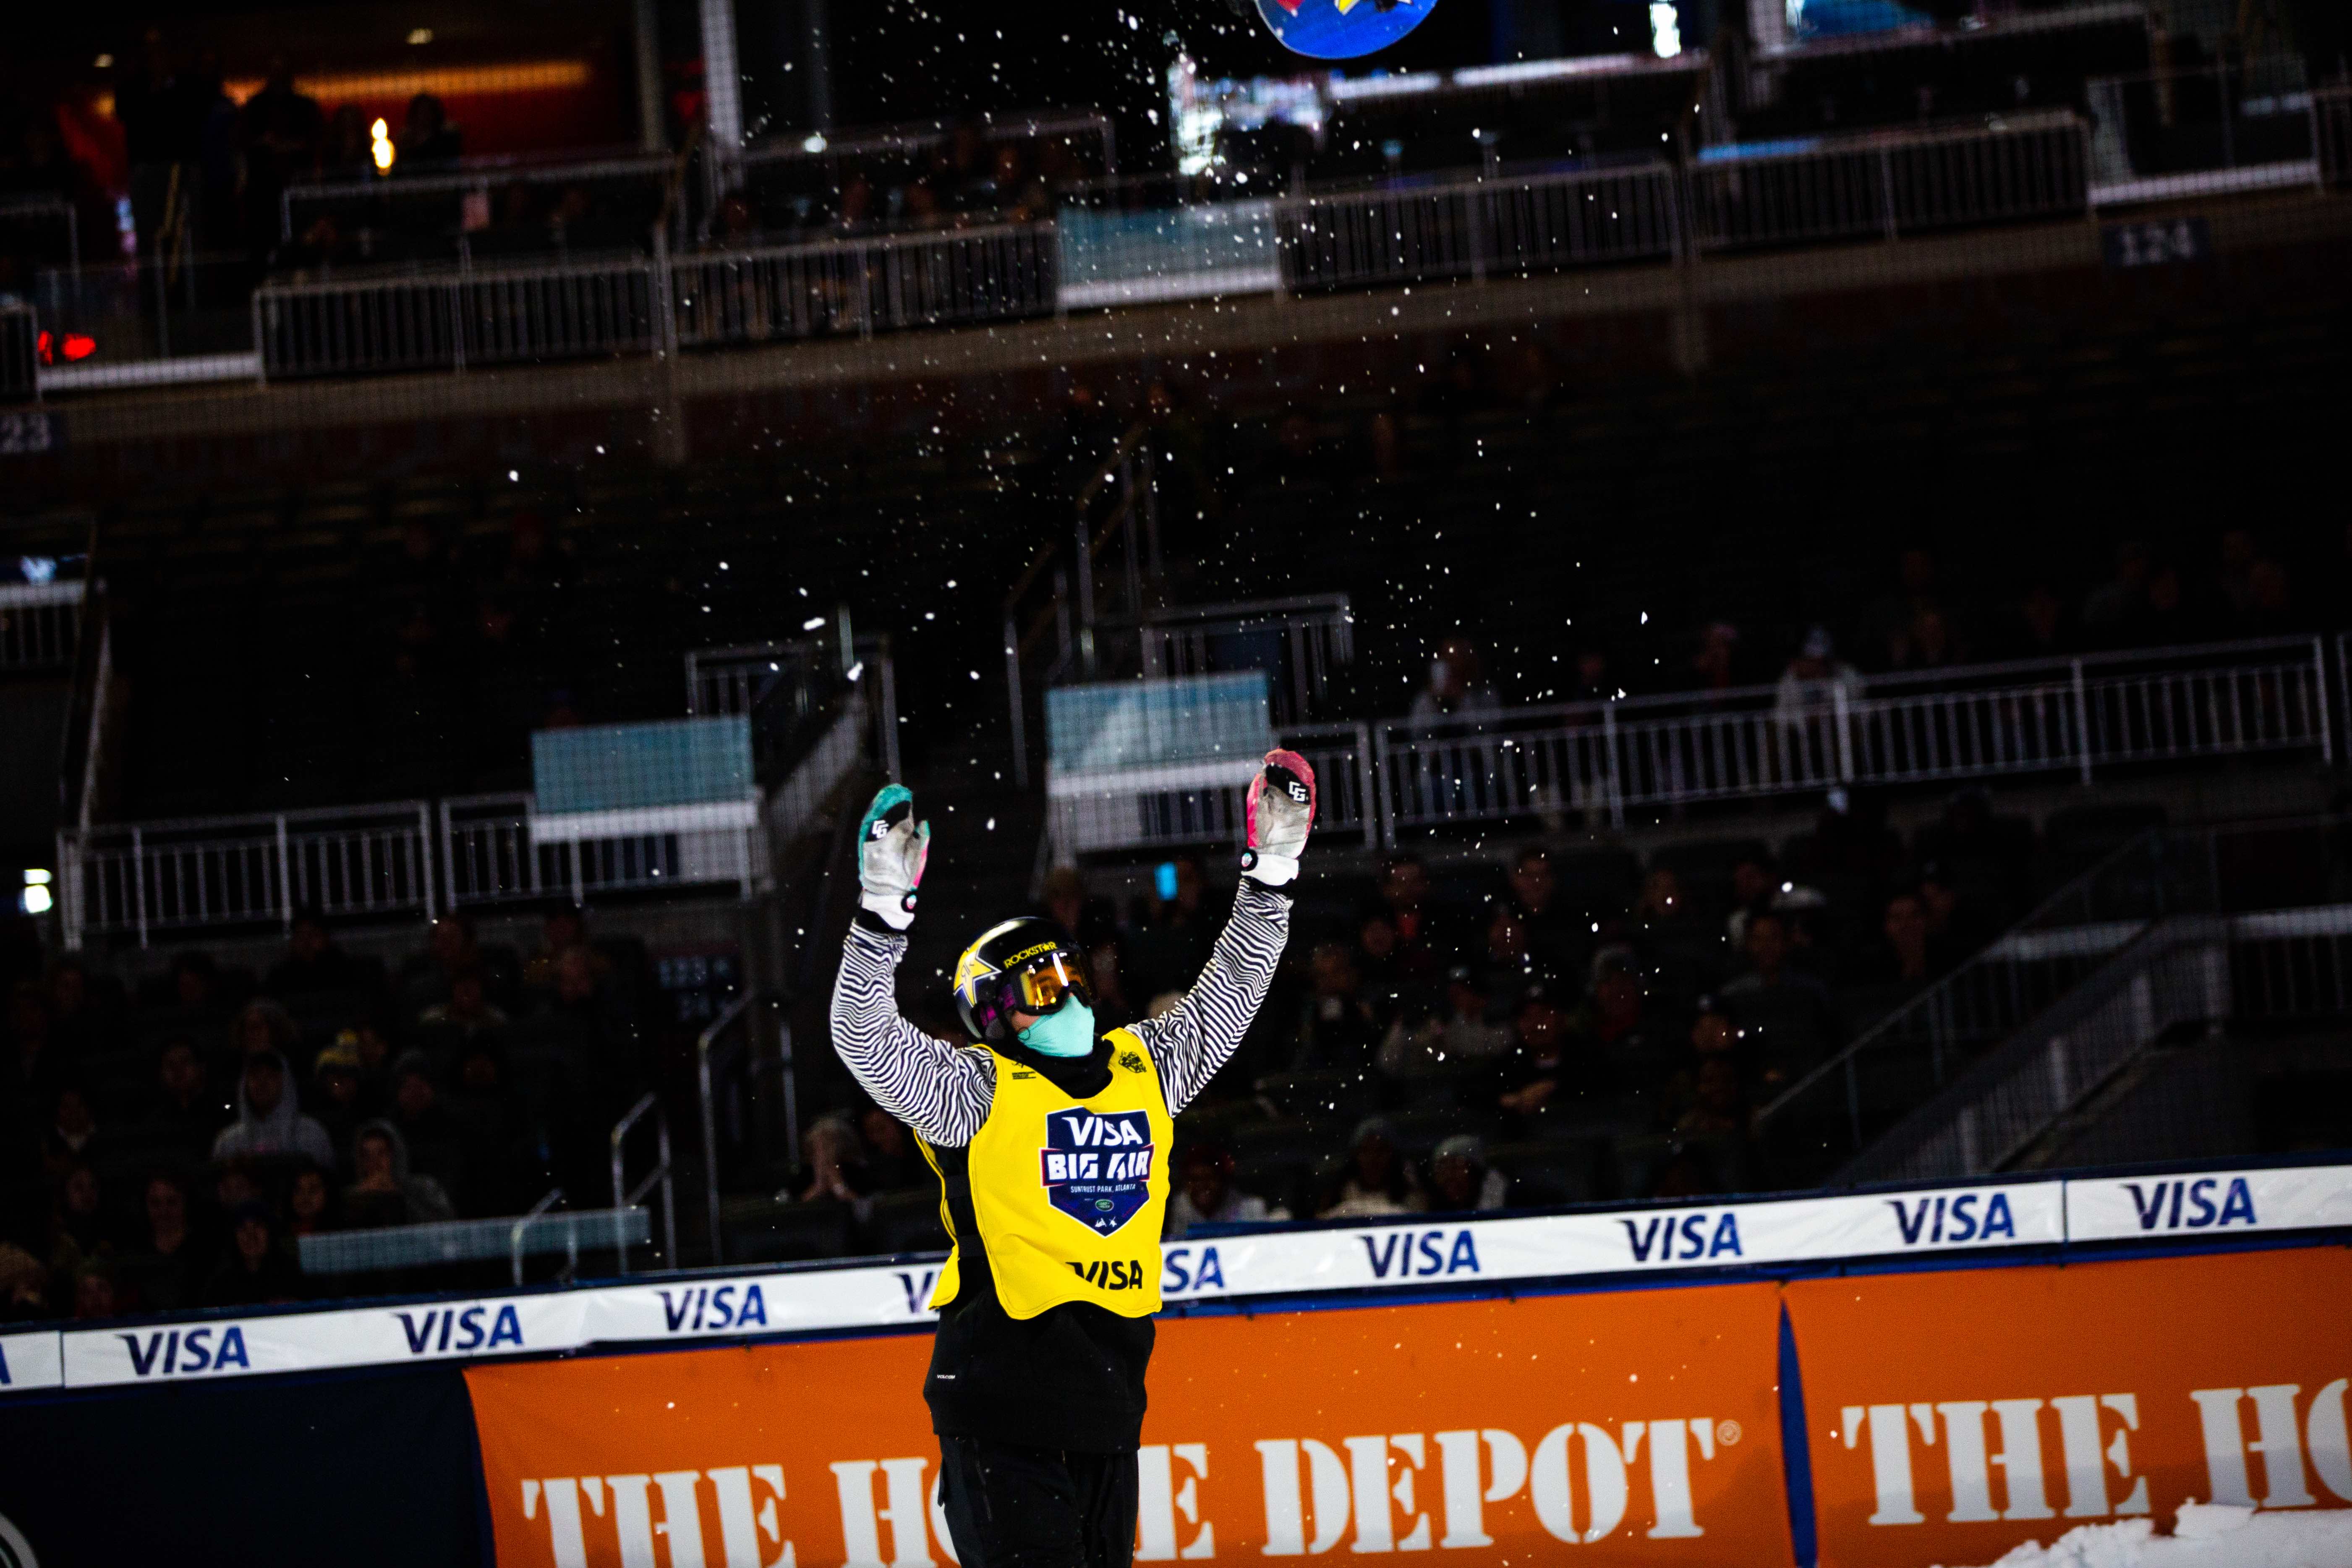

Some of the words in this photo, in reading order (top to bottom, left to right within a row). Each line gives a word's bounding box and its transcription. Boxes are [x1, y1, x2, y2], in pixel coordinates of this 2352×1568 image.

[1061, 1116, 1143, 1146] VISA
[1047, 1153, 1099, 1180] BIG
[1106, 1151, 1150, 1179] AIR
[1115, 1184, 1136, 1192] ATLANTA
[1884, 1193, 2016, 1245] VISA
[2119, 1178, 2256, 1230] VISA
[1357, 1228, 1480, 1278] VISA
[1616, 1213, 1743, 1262] VISA
[1065, 1260, 1143, 1290] VISA
[1162, 1247, 1225, 1293] SA
[391, 1304, 525, 1354] VISA
[656, 1284, 767, 1332] VISA
[115, 1325, 251, 1376] VISA
[1841, 1393, 2151, 1526] THE
[521, 1464, 797, 1568] THE
[1254, 1417, 1716, 1556] DEPOT
